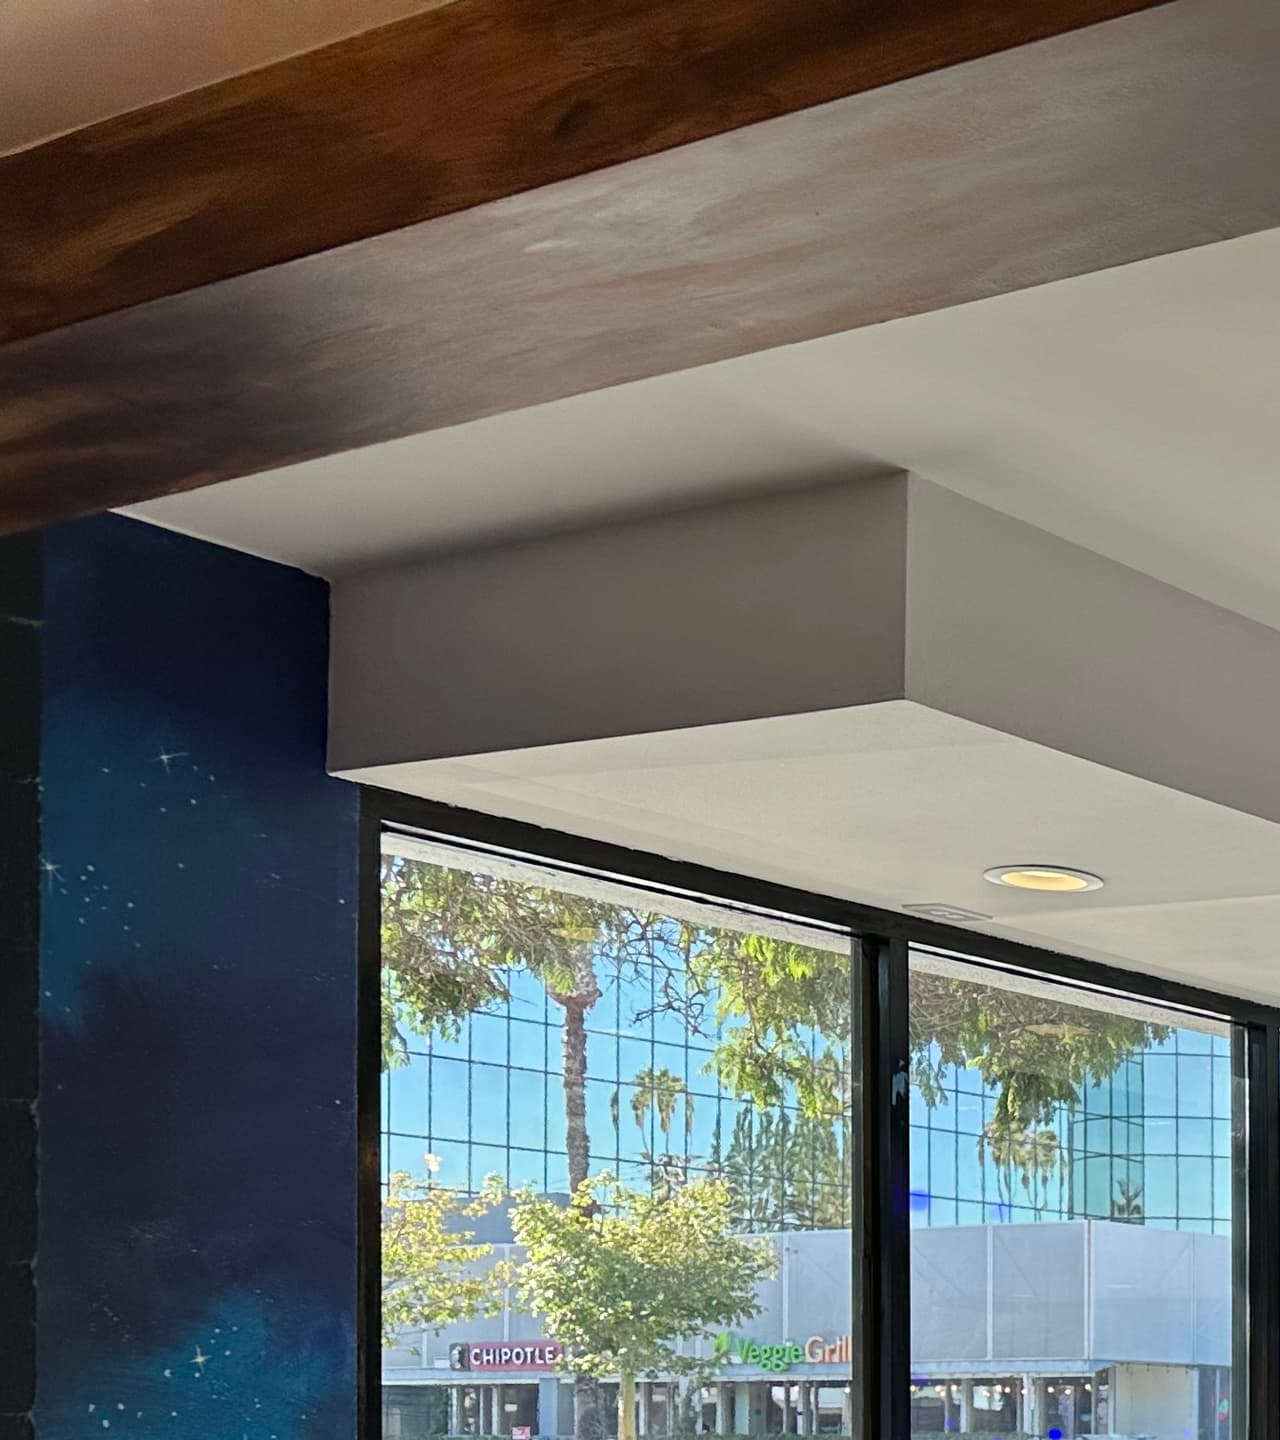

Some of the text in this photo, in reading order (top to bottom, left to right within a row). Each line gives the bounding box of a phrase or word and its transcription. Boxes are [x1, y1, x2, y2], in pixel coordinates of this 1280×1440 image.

[471, 1347, 554, 1365] CHIPOTLE
[736, 1336, 852, 1371] Veggie Grill
